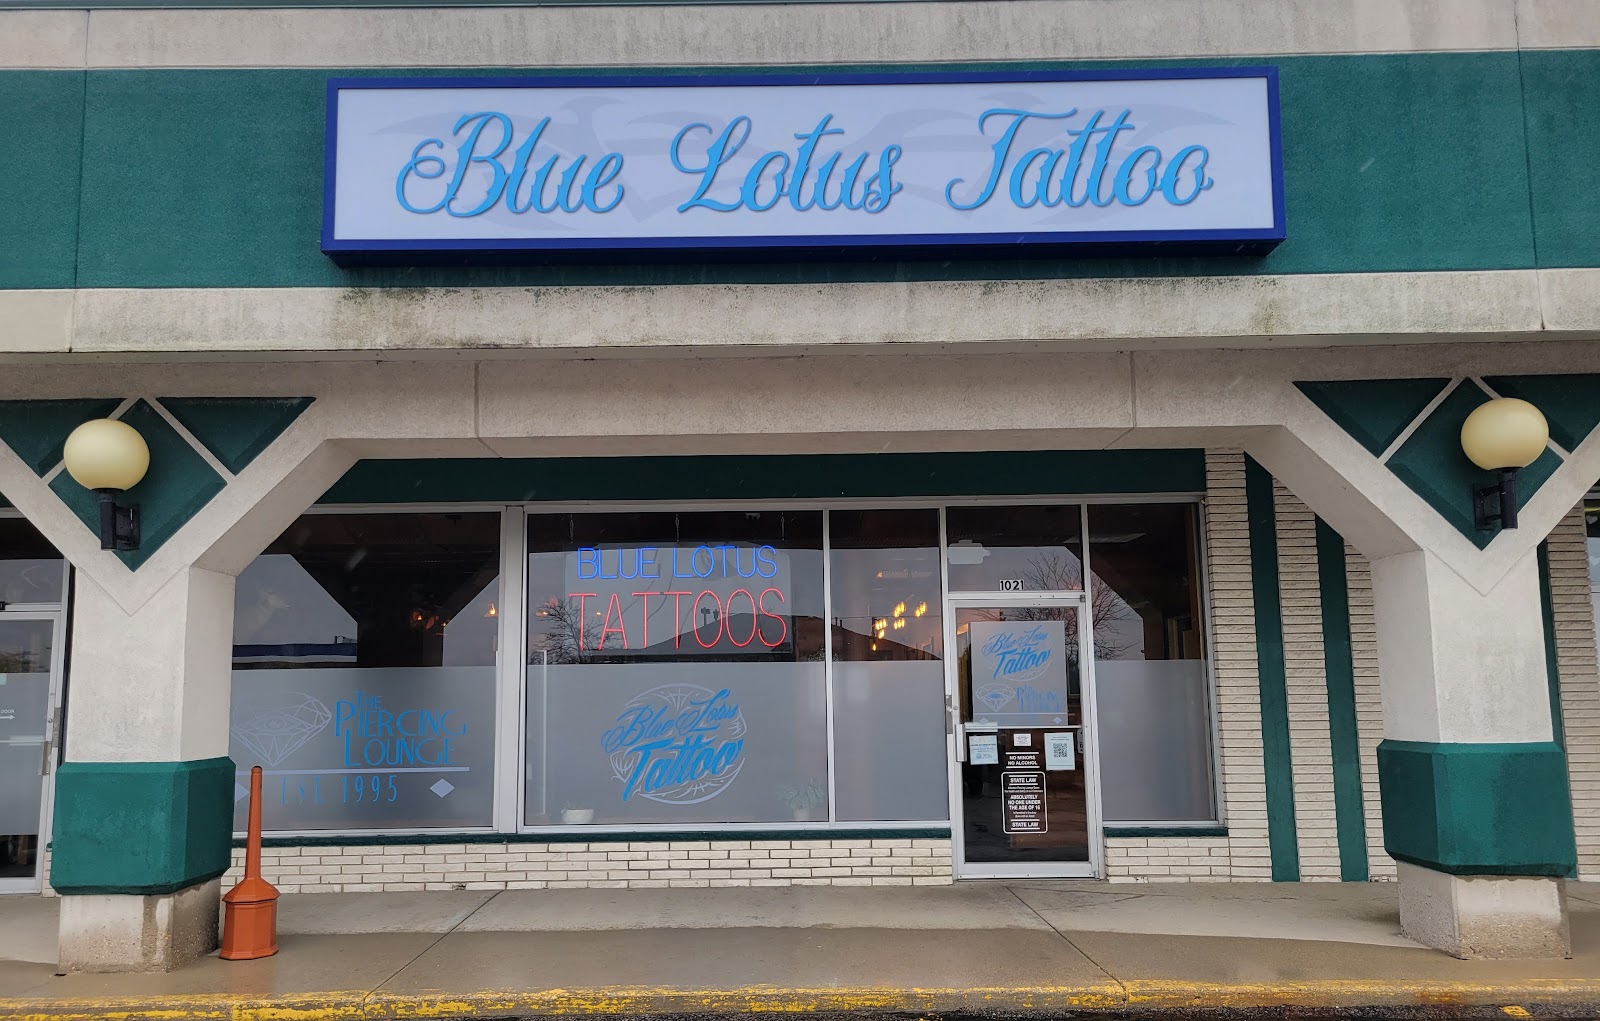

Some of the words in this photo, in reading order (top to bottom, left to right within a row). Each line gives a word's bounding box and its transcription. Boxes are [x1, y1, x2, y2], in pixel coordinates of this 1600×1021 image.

[396, 111, 625, 218] Blue
[670, 113, 902, 214] Lotus
[945, 107, 1214, 210] Tattoo
[577, 546, 660, 579] BLUE
[672, 545, 778, 578] LOTUS
[1000, 580, 1024, 591] 1021
[569, 587, 787, 651] TATTOOS
[981, 631, 1022, 656] Blue
[993, 647, 1051, 680] Tattoo
[356, 690, 383, 709] THE
[335, 700, 467, 737] PIERCING
[601, 704, 675, 753] Blue
[675, 688, 740, 736] Lotus
[345, 729, 458, 767] LOUNGE
[623, 734, 744, 801] Tattoo
[343, 775, 397, 802] 1995
